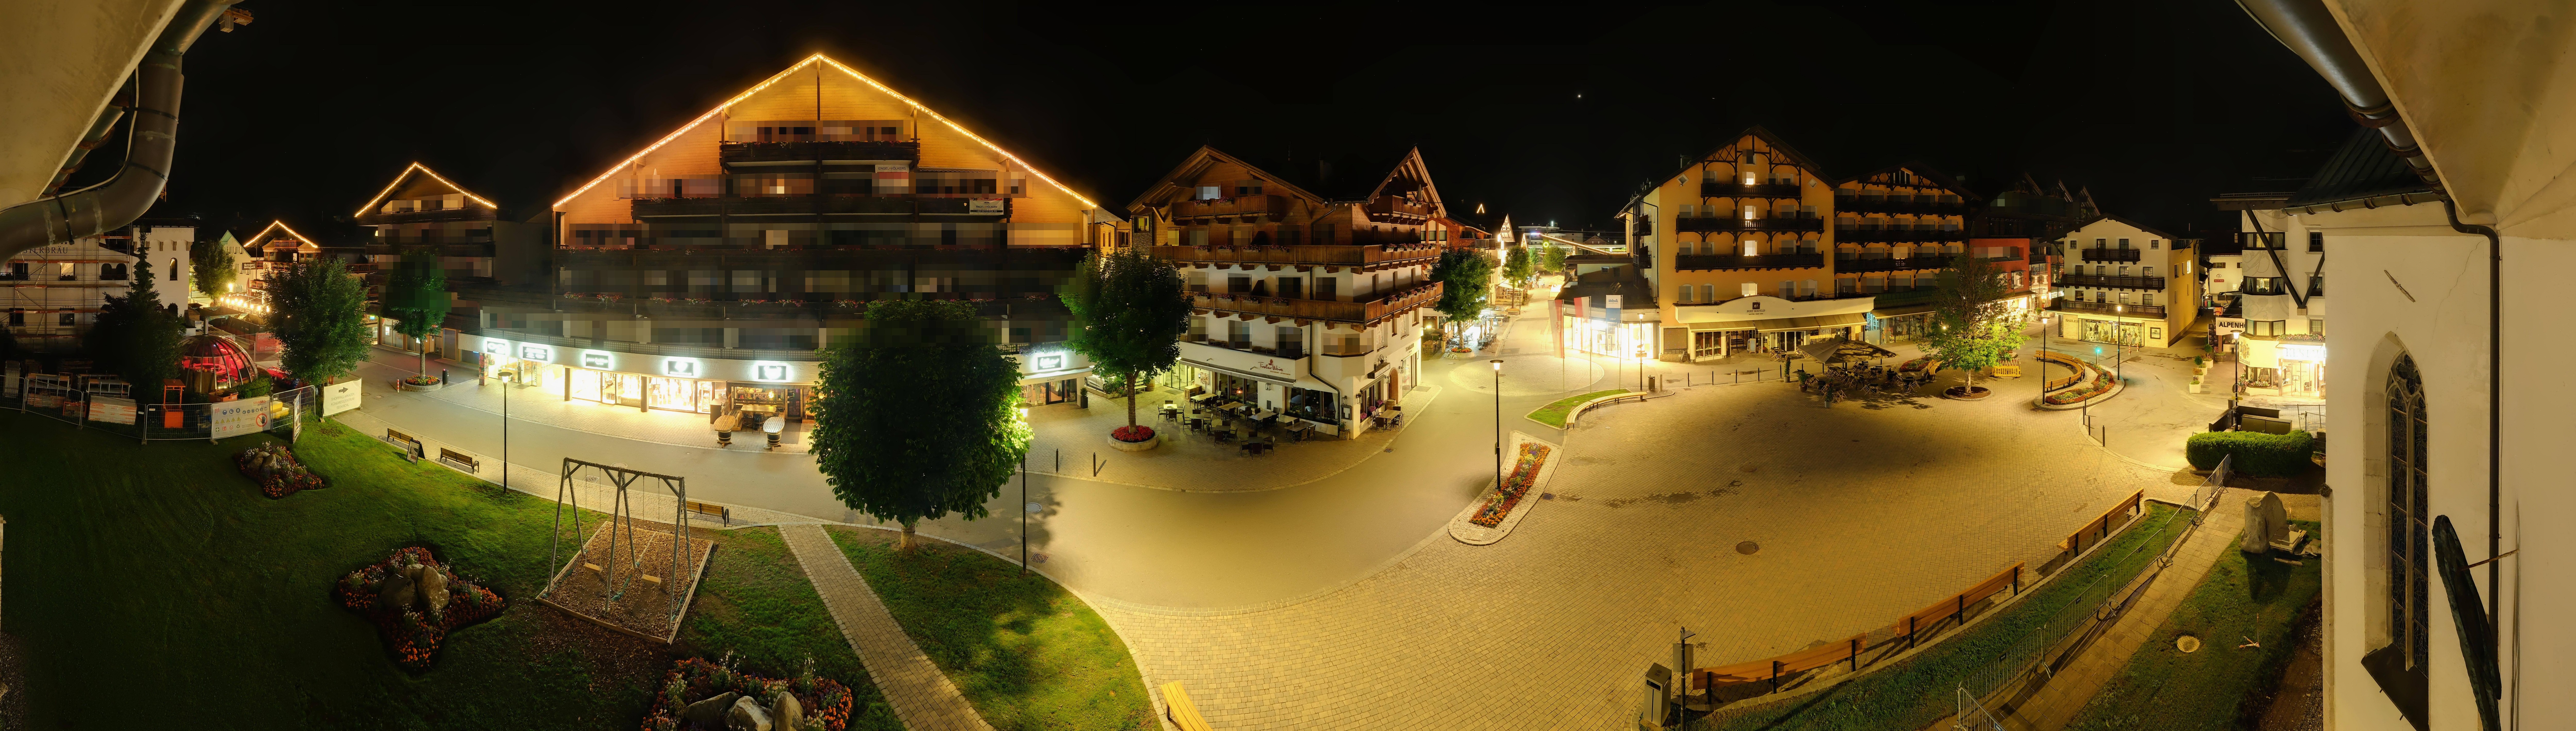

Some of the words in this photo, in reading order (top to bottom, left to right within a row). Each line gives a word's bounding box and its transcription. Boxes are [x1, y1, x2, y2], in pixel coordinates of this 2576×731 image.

[2239, 356, 2250, 365] Kaltschmid
[1375, 365, 1389, 377] RESTAURANT
[331, 397, 354, 406] KONGRESSZENTRUM
